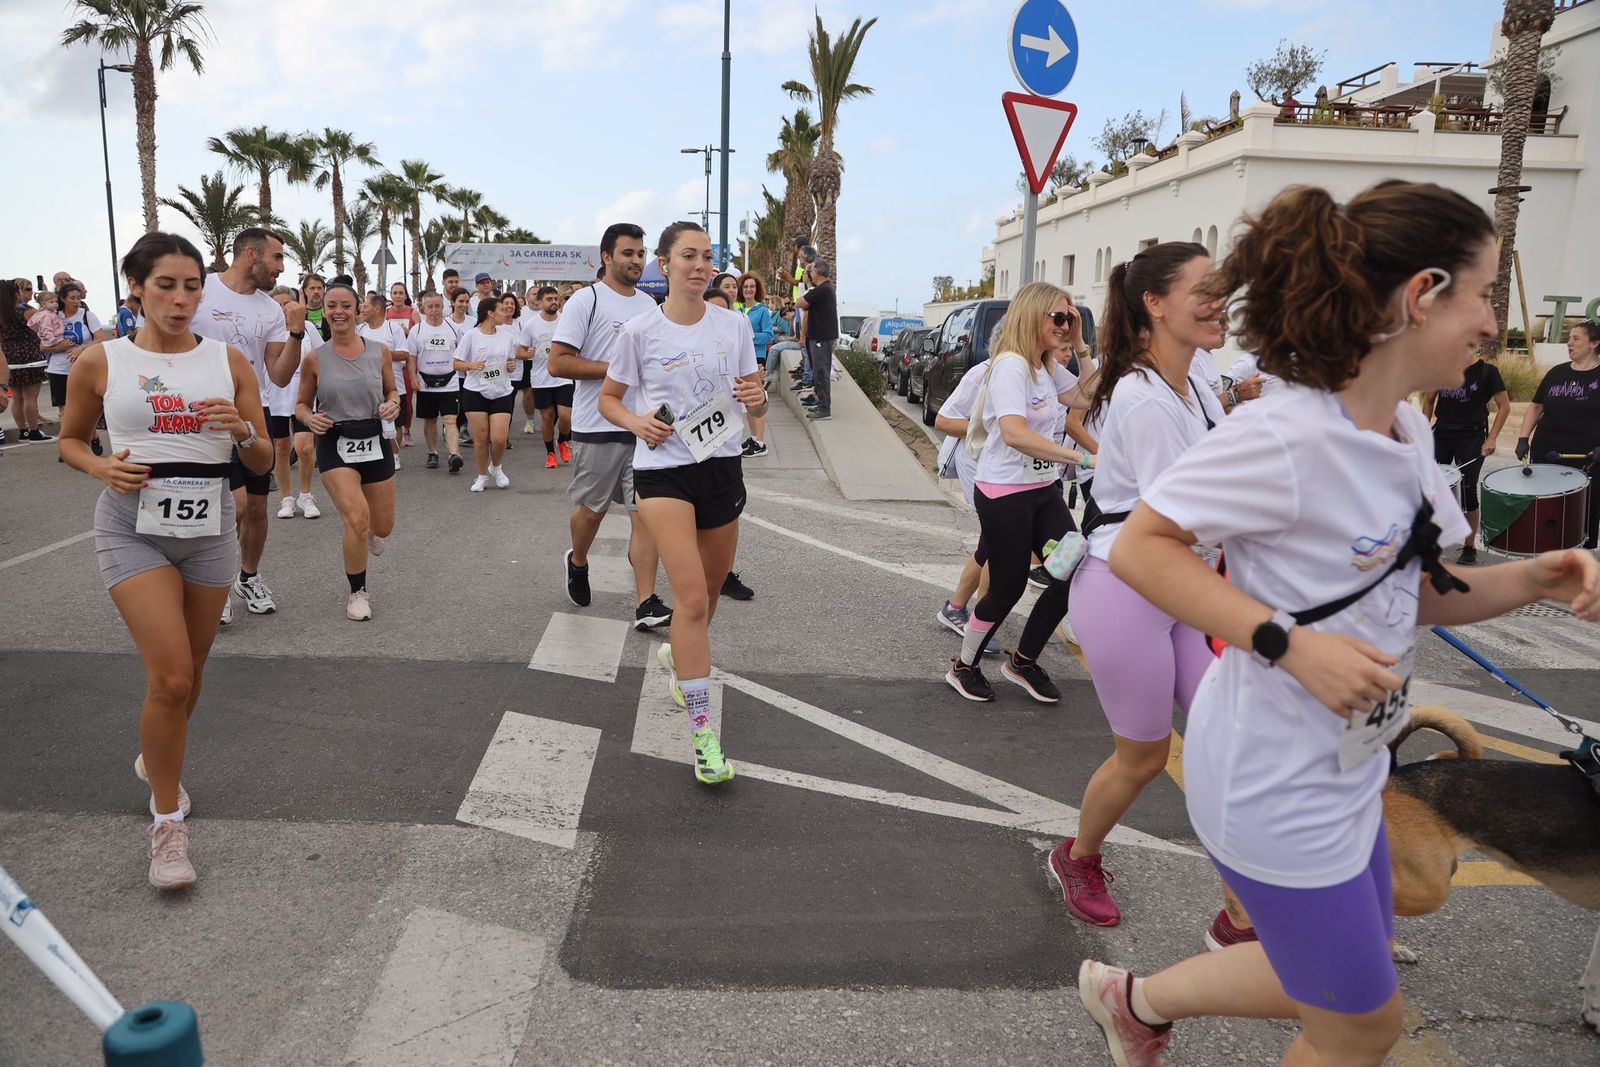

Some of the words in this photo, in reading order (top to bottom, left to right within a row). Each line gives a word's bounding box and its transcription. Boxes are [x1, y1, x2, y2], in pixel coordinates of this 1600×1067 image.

[509, 250, 522, 258] 3A
[523, 250, 568, 258] CARRERA
[570, 250, 582, 258] 5K
[430, 338, 445, 346] 422
[483, 369, 501, 379] 389
[146, 394, 186, 413] TOM
[148, 413, 206, 434] JERRY
[690, 410, 725, 443] 779
[345, 439, 373, 454] 241
[157, 497, 209, 521] 152
